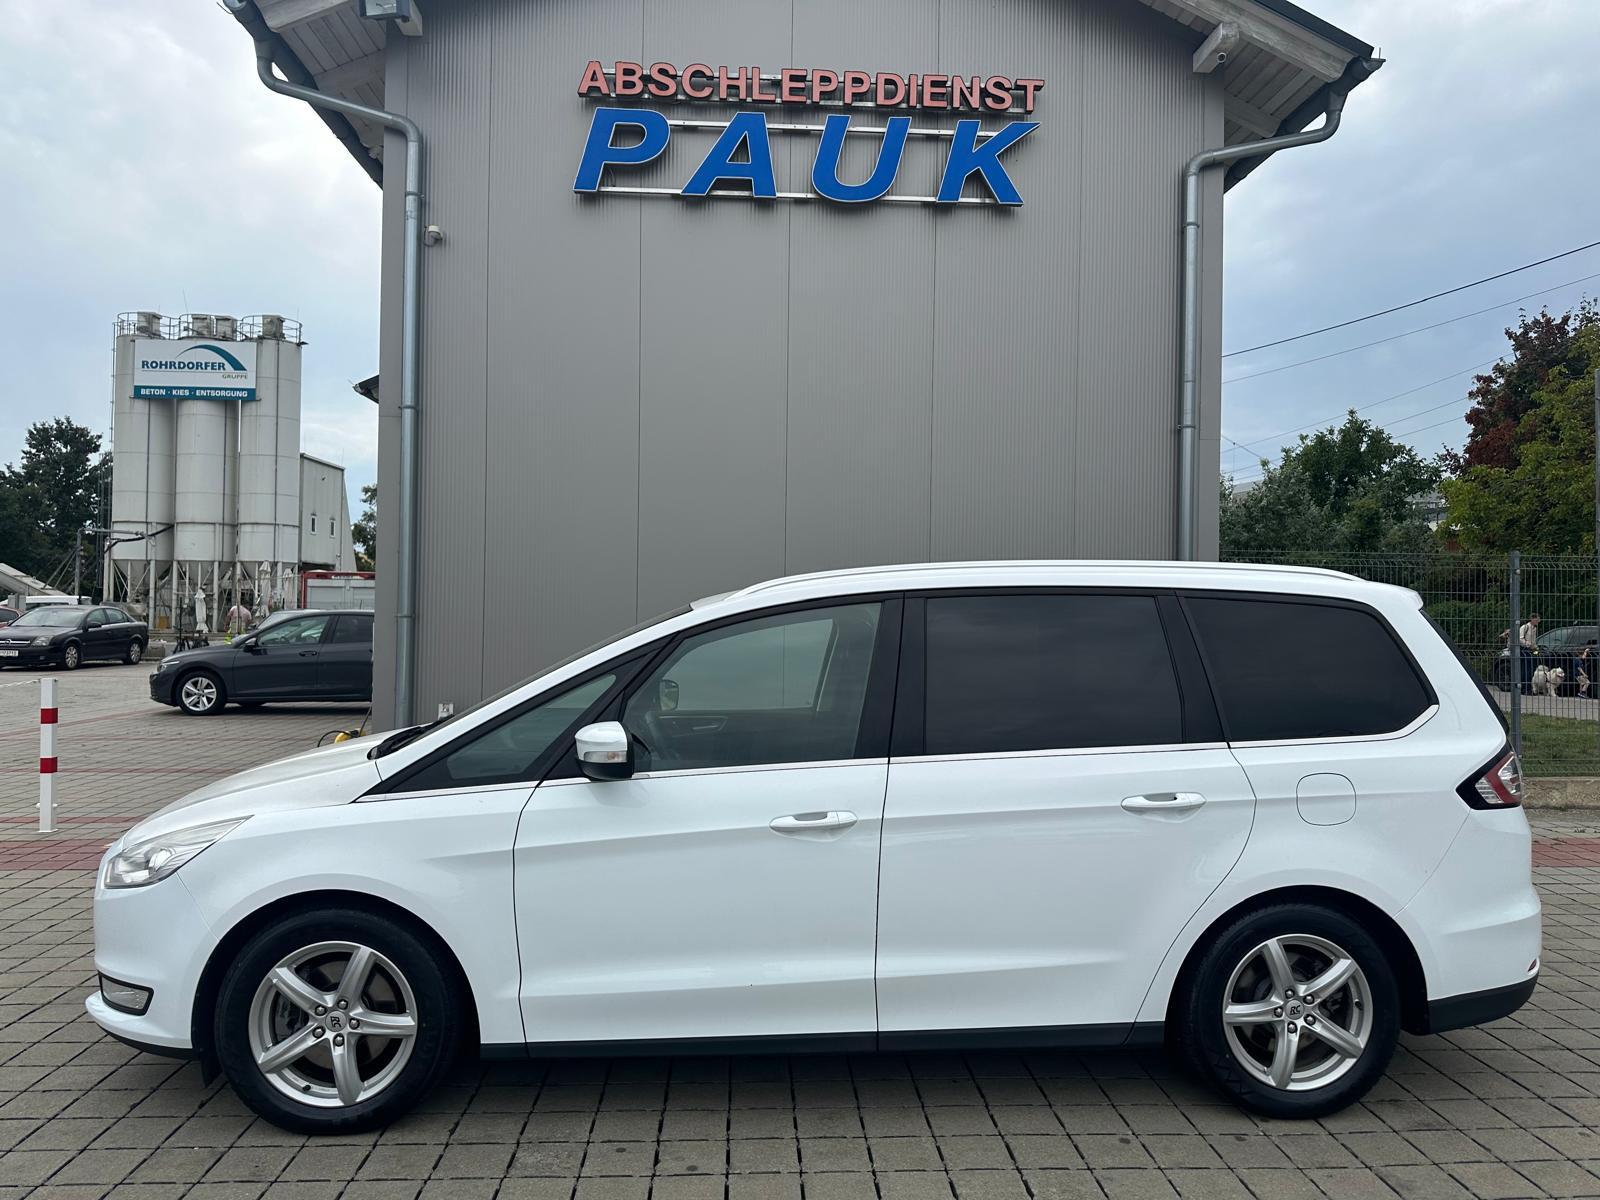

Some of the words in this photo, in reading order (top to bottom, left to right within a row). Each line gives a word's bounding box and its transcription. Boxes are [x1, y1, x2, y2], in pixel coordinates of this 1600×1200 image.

[577, 60, 1045, 113] ABSCHLEPPDIENST
[573, 106, 1042, 206] PAUK
[141, 359, 226, 371] ROHRDORFER
[196, 389, 248, 397] ENTSORGUNG
